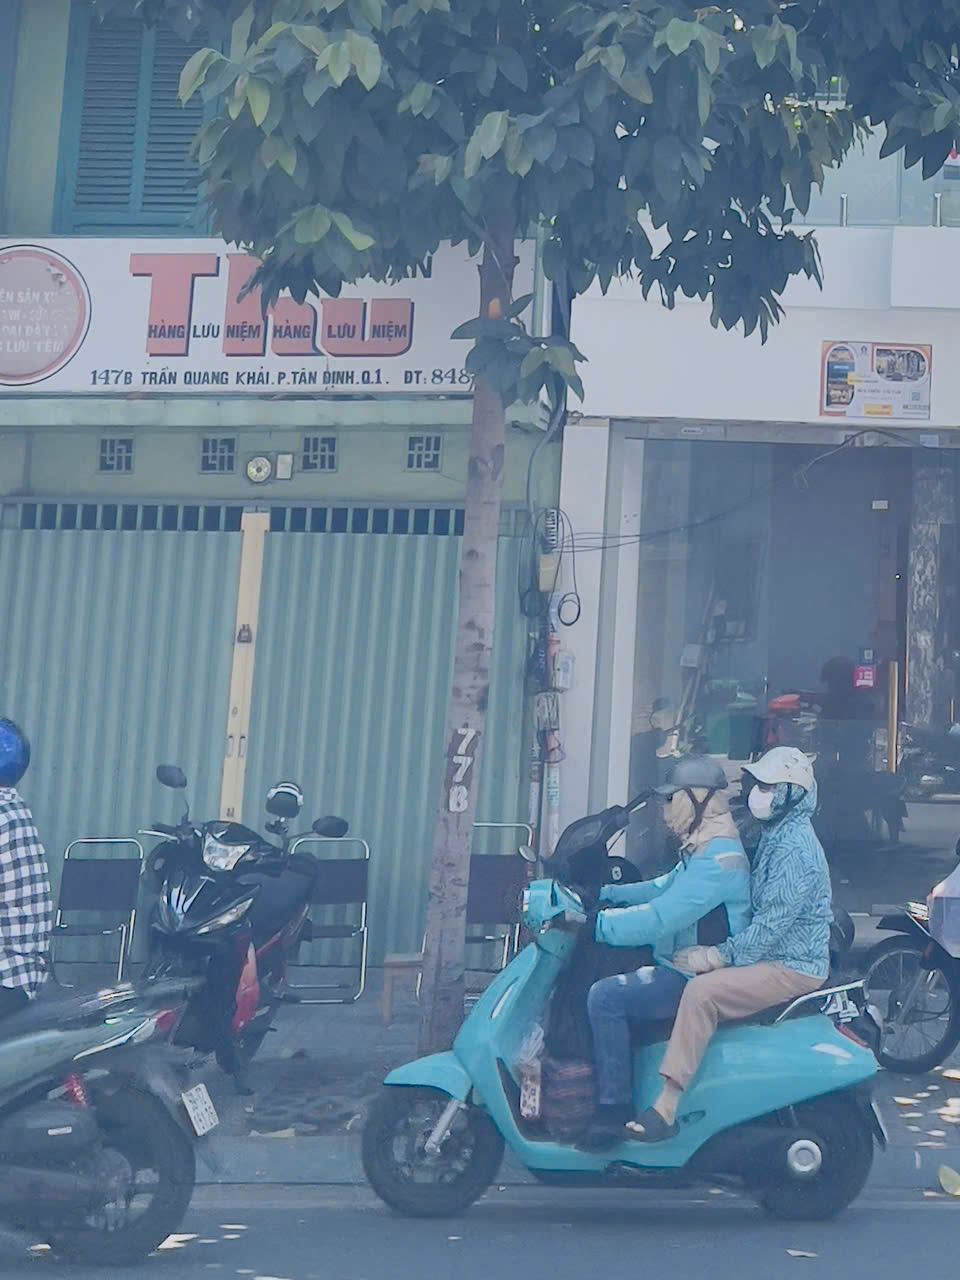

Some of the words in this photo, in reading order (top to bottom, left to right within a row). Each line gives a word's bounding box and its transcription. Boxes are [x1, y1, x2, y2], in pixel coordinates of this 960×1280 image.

[148, 319, 185, 339] HÀNG
[192, 322, 220, 339] LƯU
[226, 321, 261, 342] NIỆM
[273, 319, 311, 339] HÀNG
[327, 322, 356, 339] LƯU
[371, 320, 407, 342] NIỆM
[90, 369, 133, 385] 147B
[183, 370, 229, 385] QUANG
